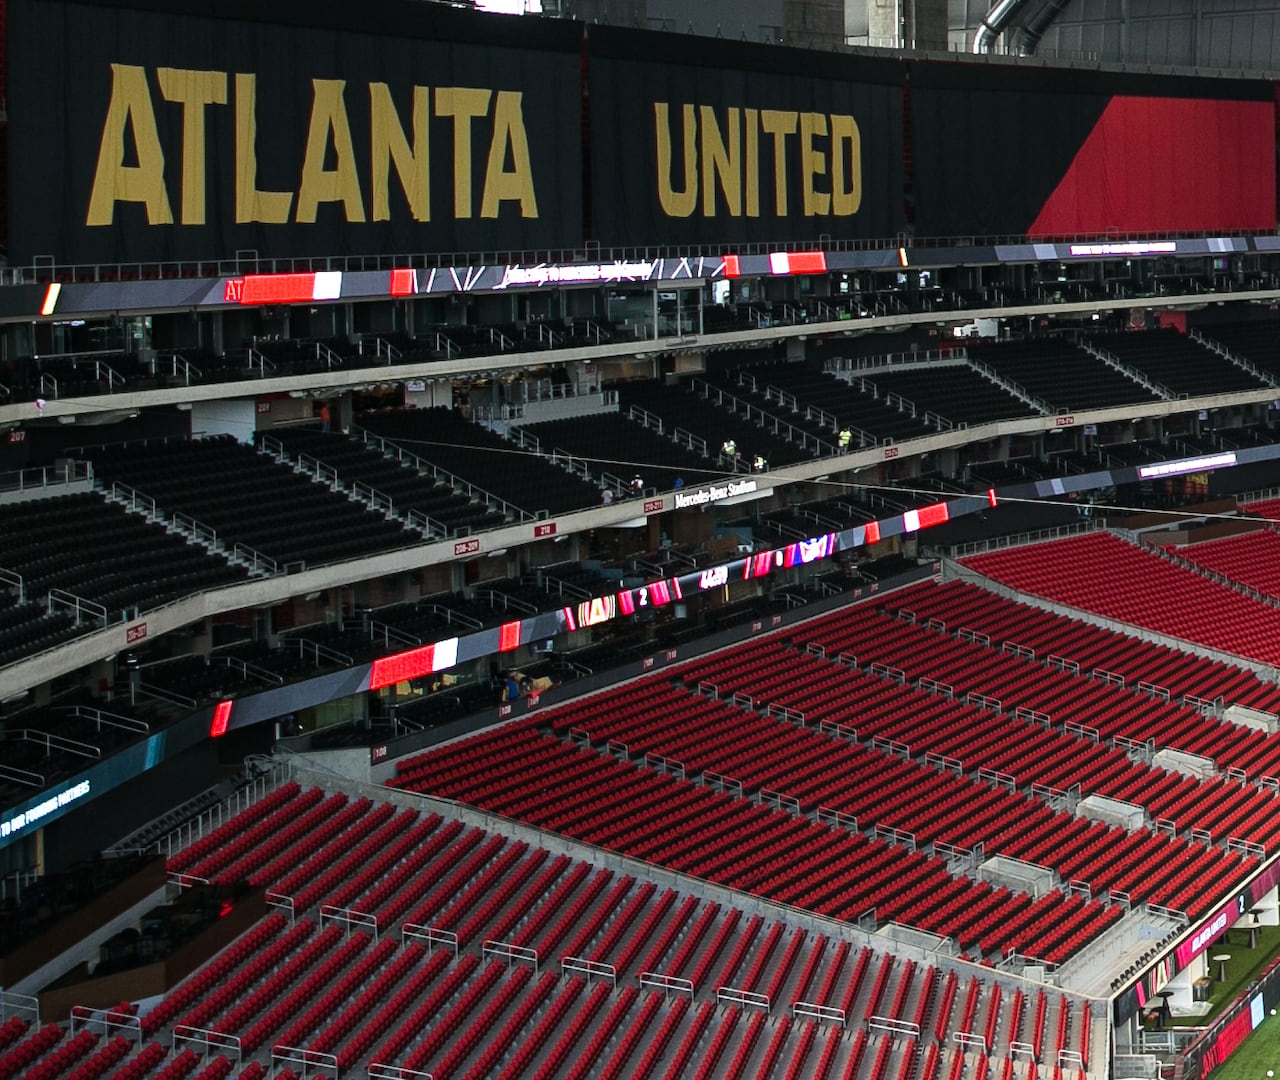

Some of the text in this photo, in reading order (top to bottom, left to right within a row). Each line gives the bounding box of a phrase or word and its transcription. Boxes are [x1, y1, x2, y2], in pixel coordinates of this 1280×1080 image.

[86, 63, 862, 226] ATLANTA UNITED
[10, 432, 25, 441] 207
[675, 480, 757, 509] Mercedes-Benz Stadium
[541, 526, 551, 535] 210
[640, 588, 648, 606] 2
[376, 745, 387, 758] 108
[58, 780, 90, 807] PARTNERS
[1239, 895, 1245, 913] 2
